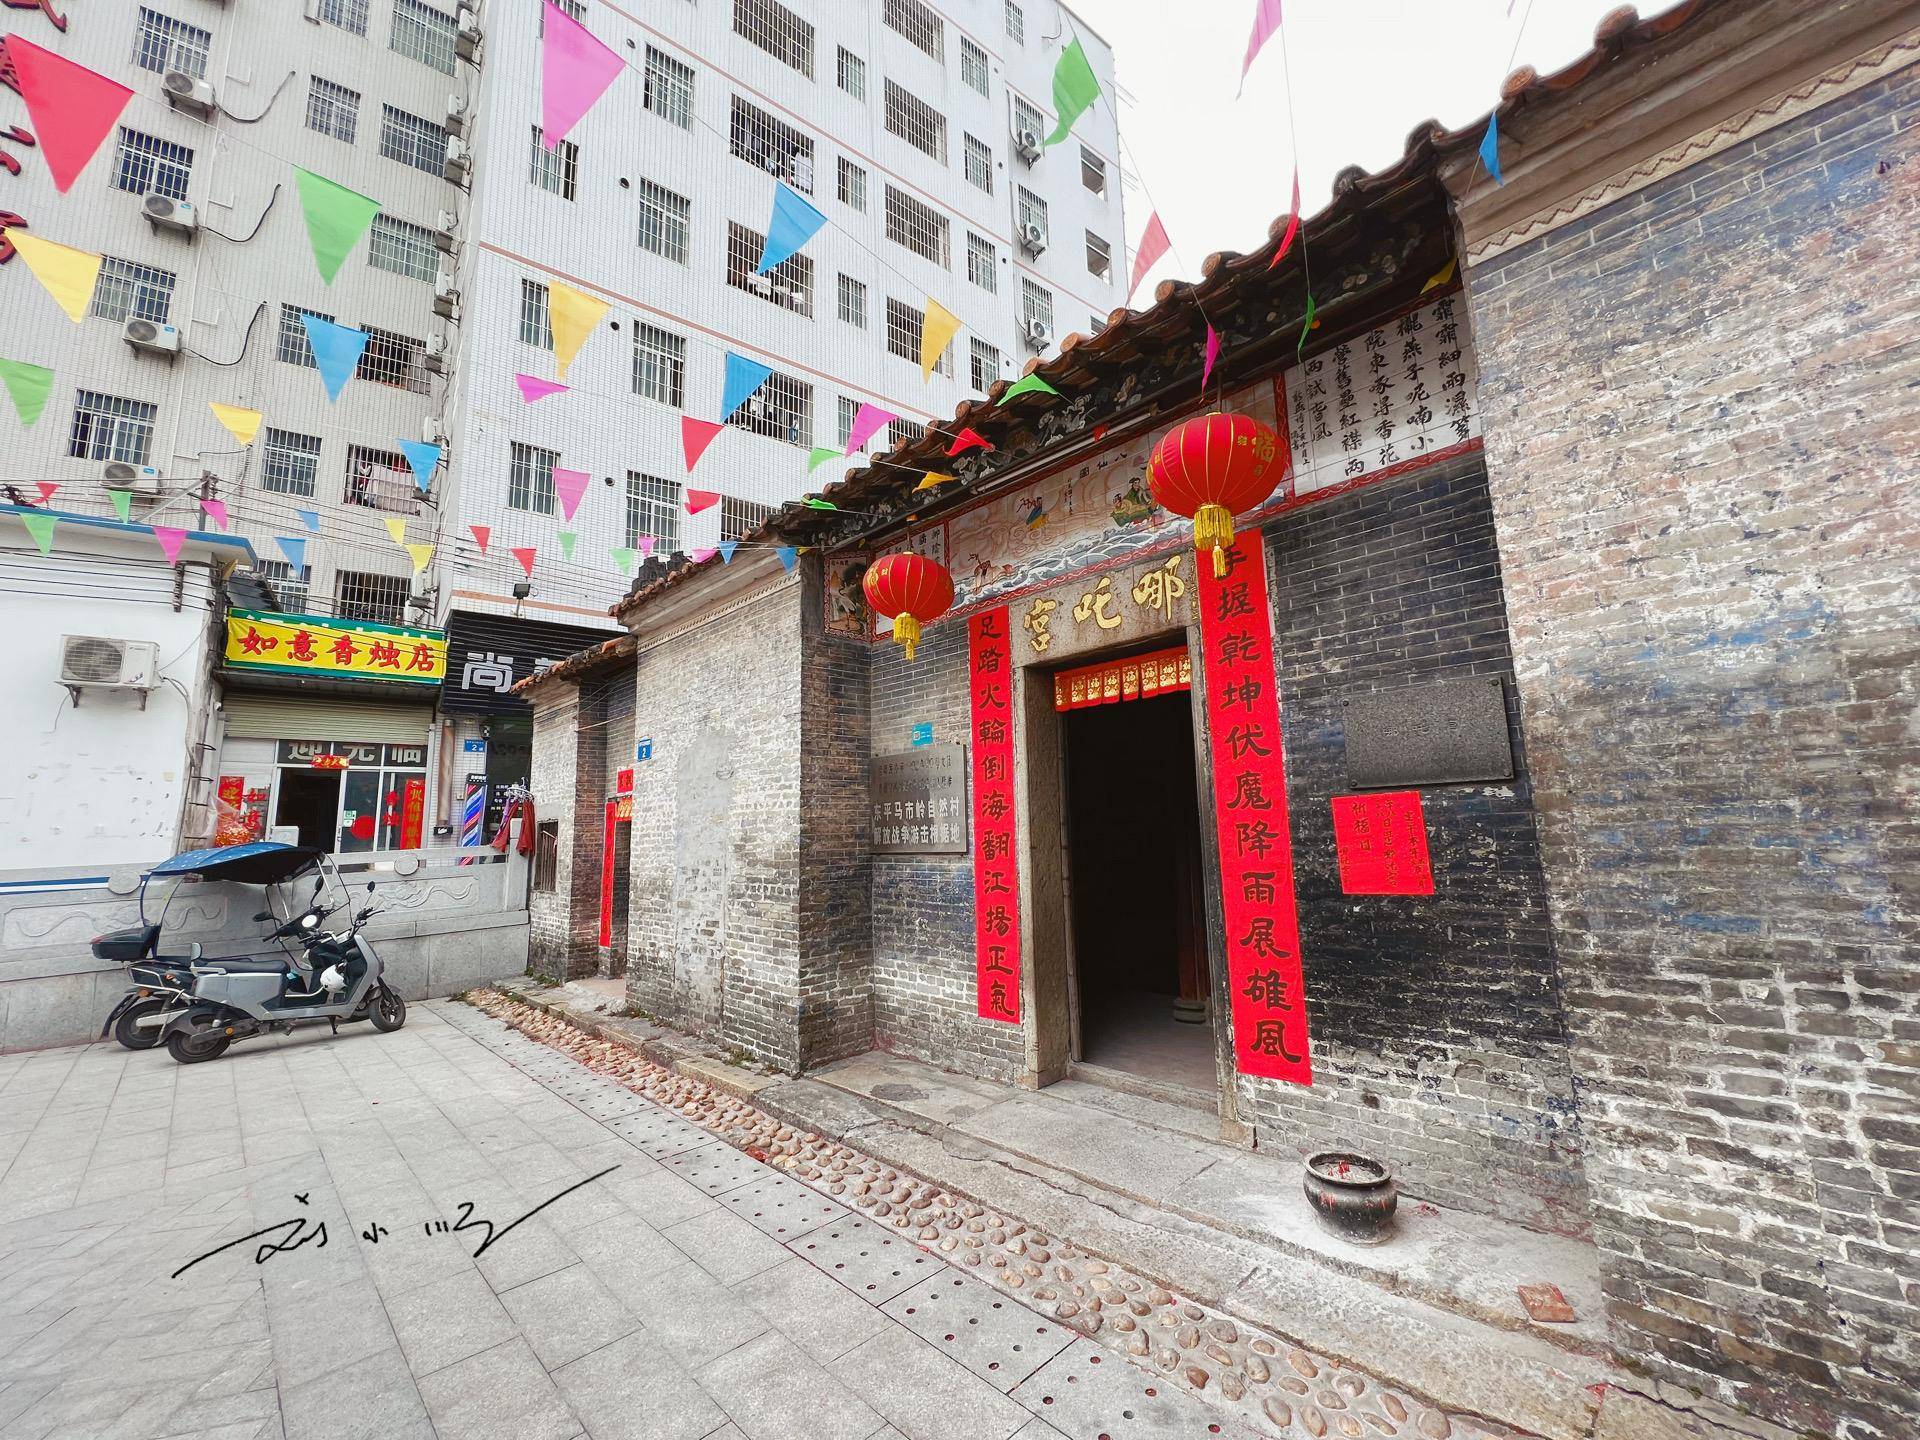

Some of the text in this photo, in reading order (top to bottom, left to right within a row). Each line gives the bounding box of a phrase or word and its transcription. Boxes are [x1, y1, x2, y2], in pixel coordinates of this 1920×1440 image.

[236, 625, 436, 672] 如意香烛店
